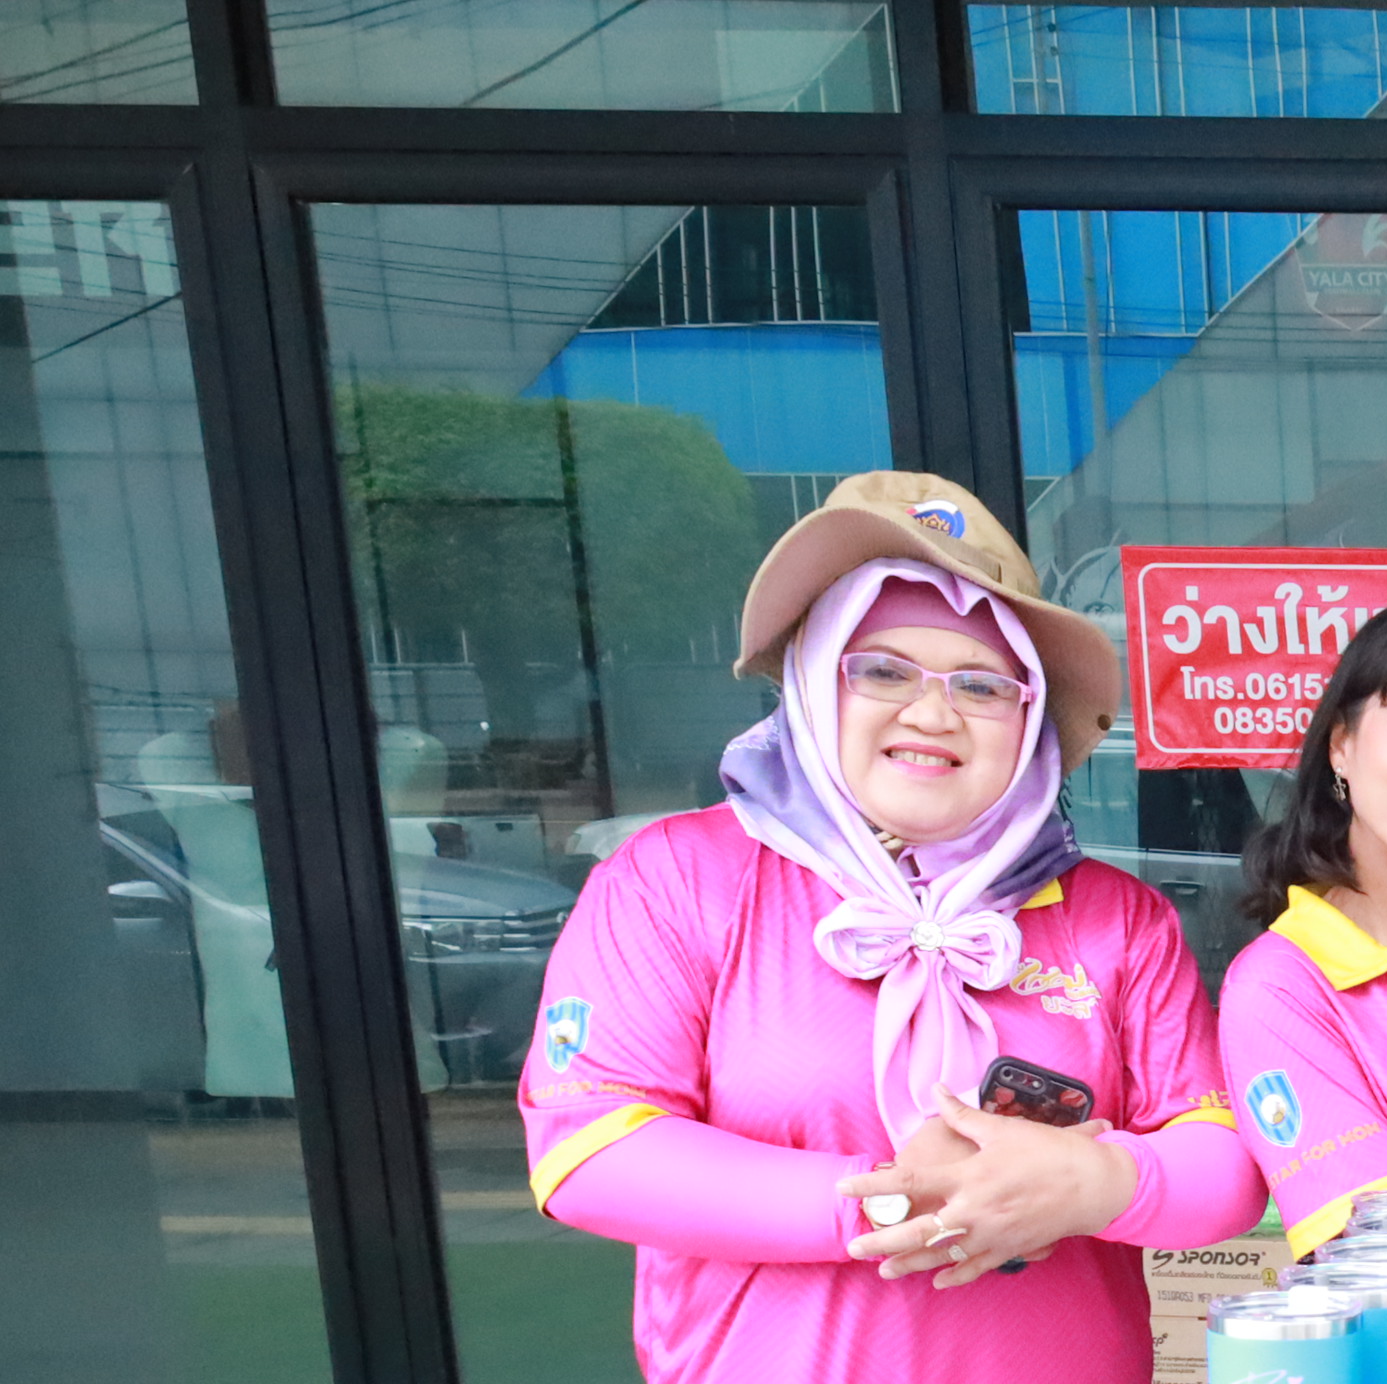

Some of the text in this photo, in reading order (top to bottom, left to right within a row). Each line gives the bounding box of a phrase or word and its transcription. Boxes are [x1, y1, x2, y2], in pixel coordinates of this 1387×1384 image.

[1309, 271, 1353, 287] YALA
[1180, 666, 1332, 700] โทร.0615
[1177, 1251, 1261, 1267] SPONSOR
